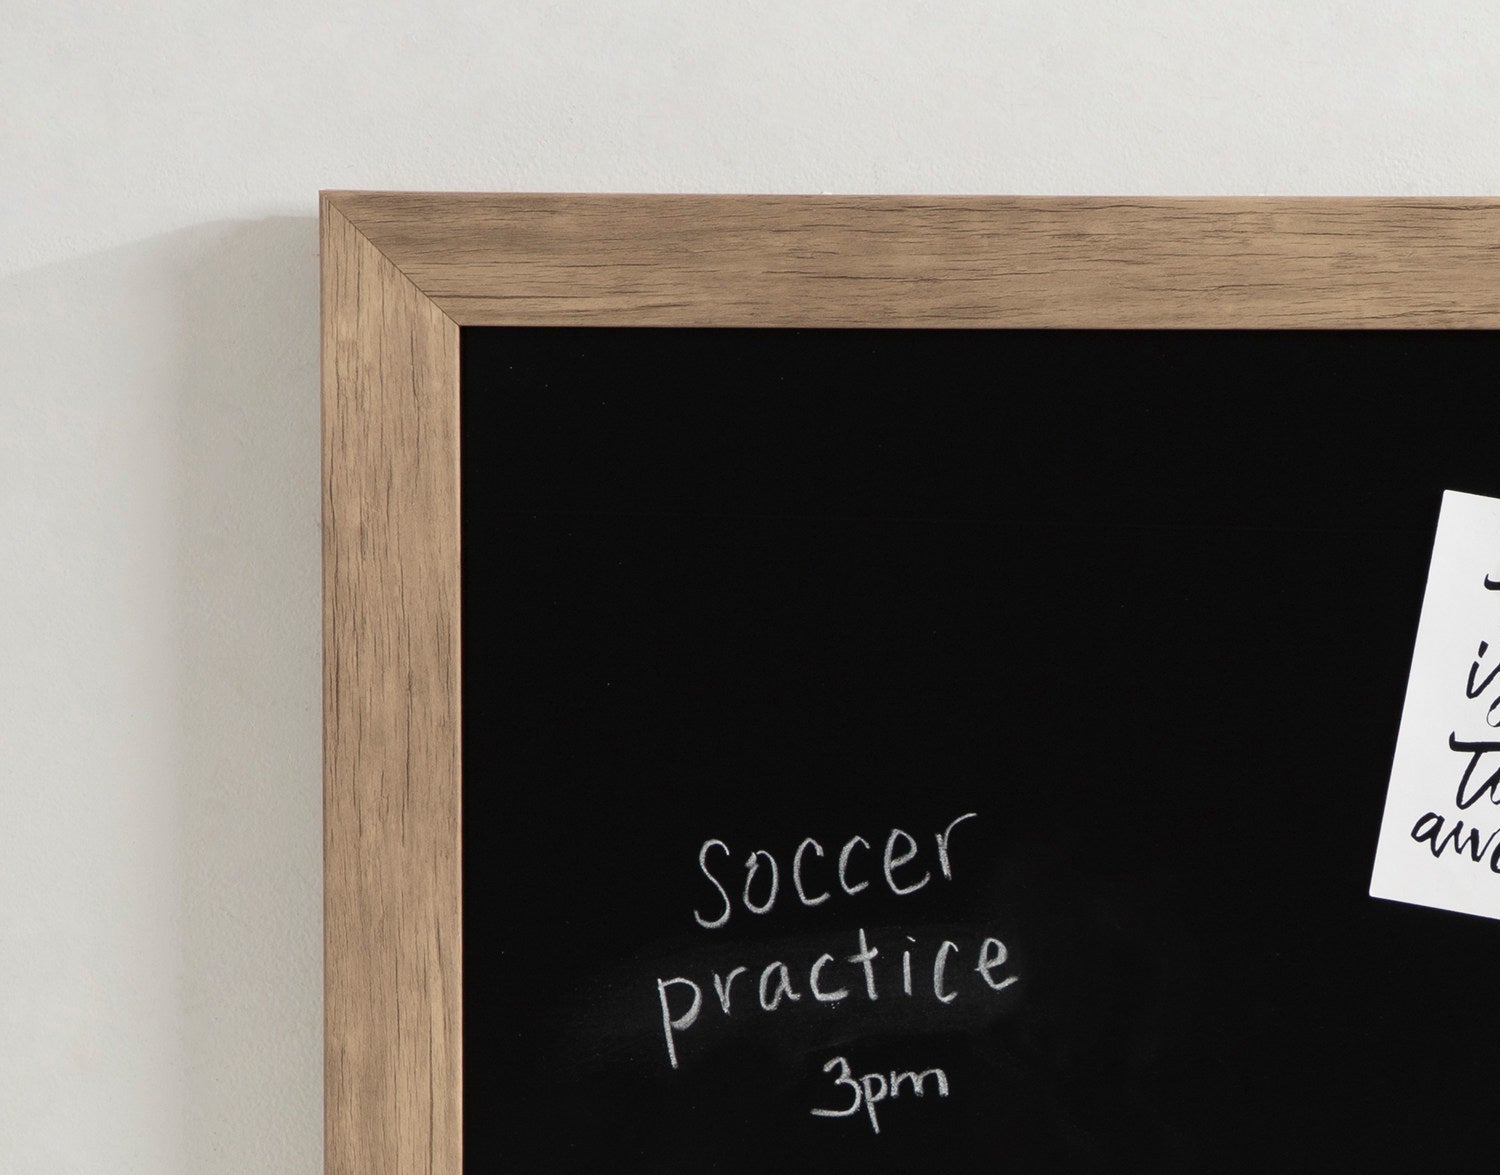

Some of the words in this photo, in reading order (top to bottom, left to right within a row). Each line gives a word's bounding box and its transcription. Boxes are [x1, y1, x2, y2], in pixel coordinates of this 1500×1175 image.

[694, 813, 976, 928] soccer
[657, 928, 1018, 1068] practice
[811, 1057, 949, 1134] 3pm
